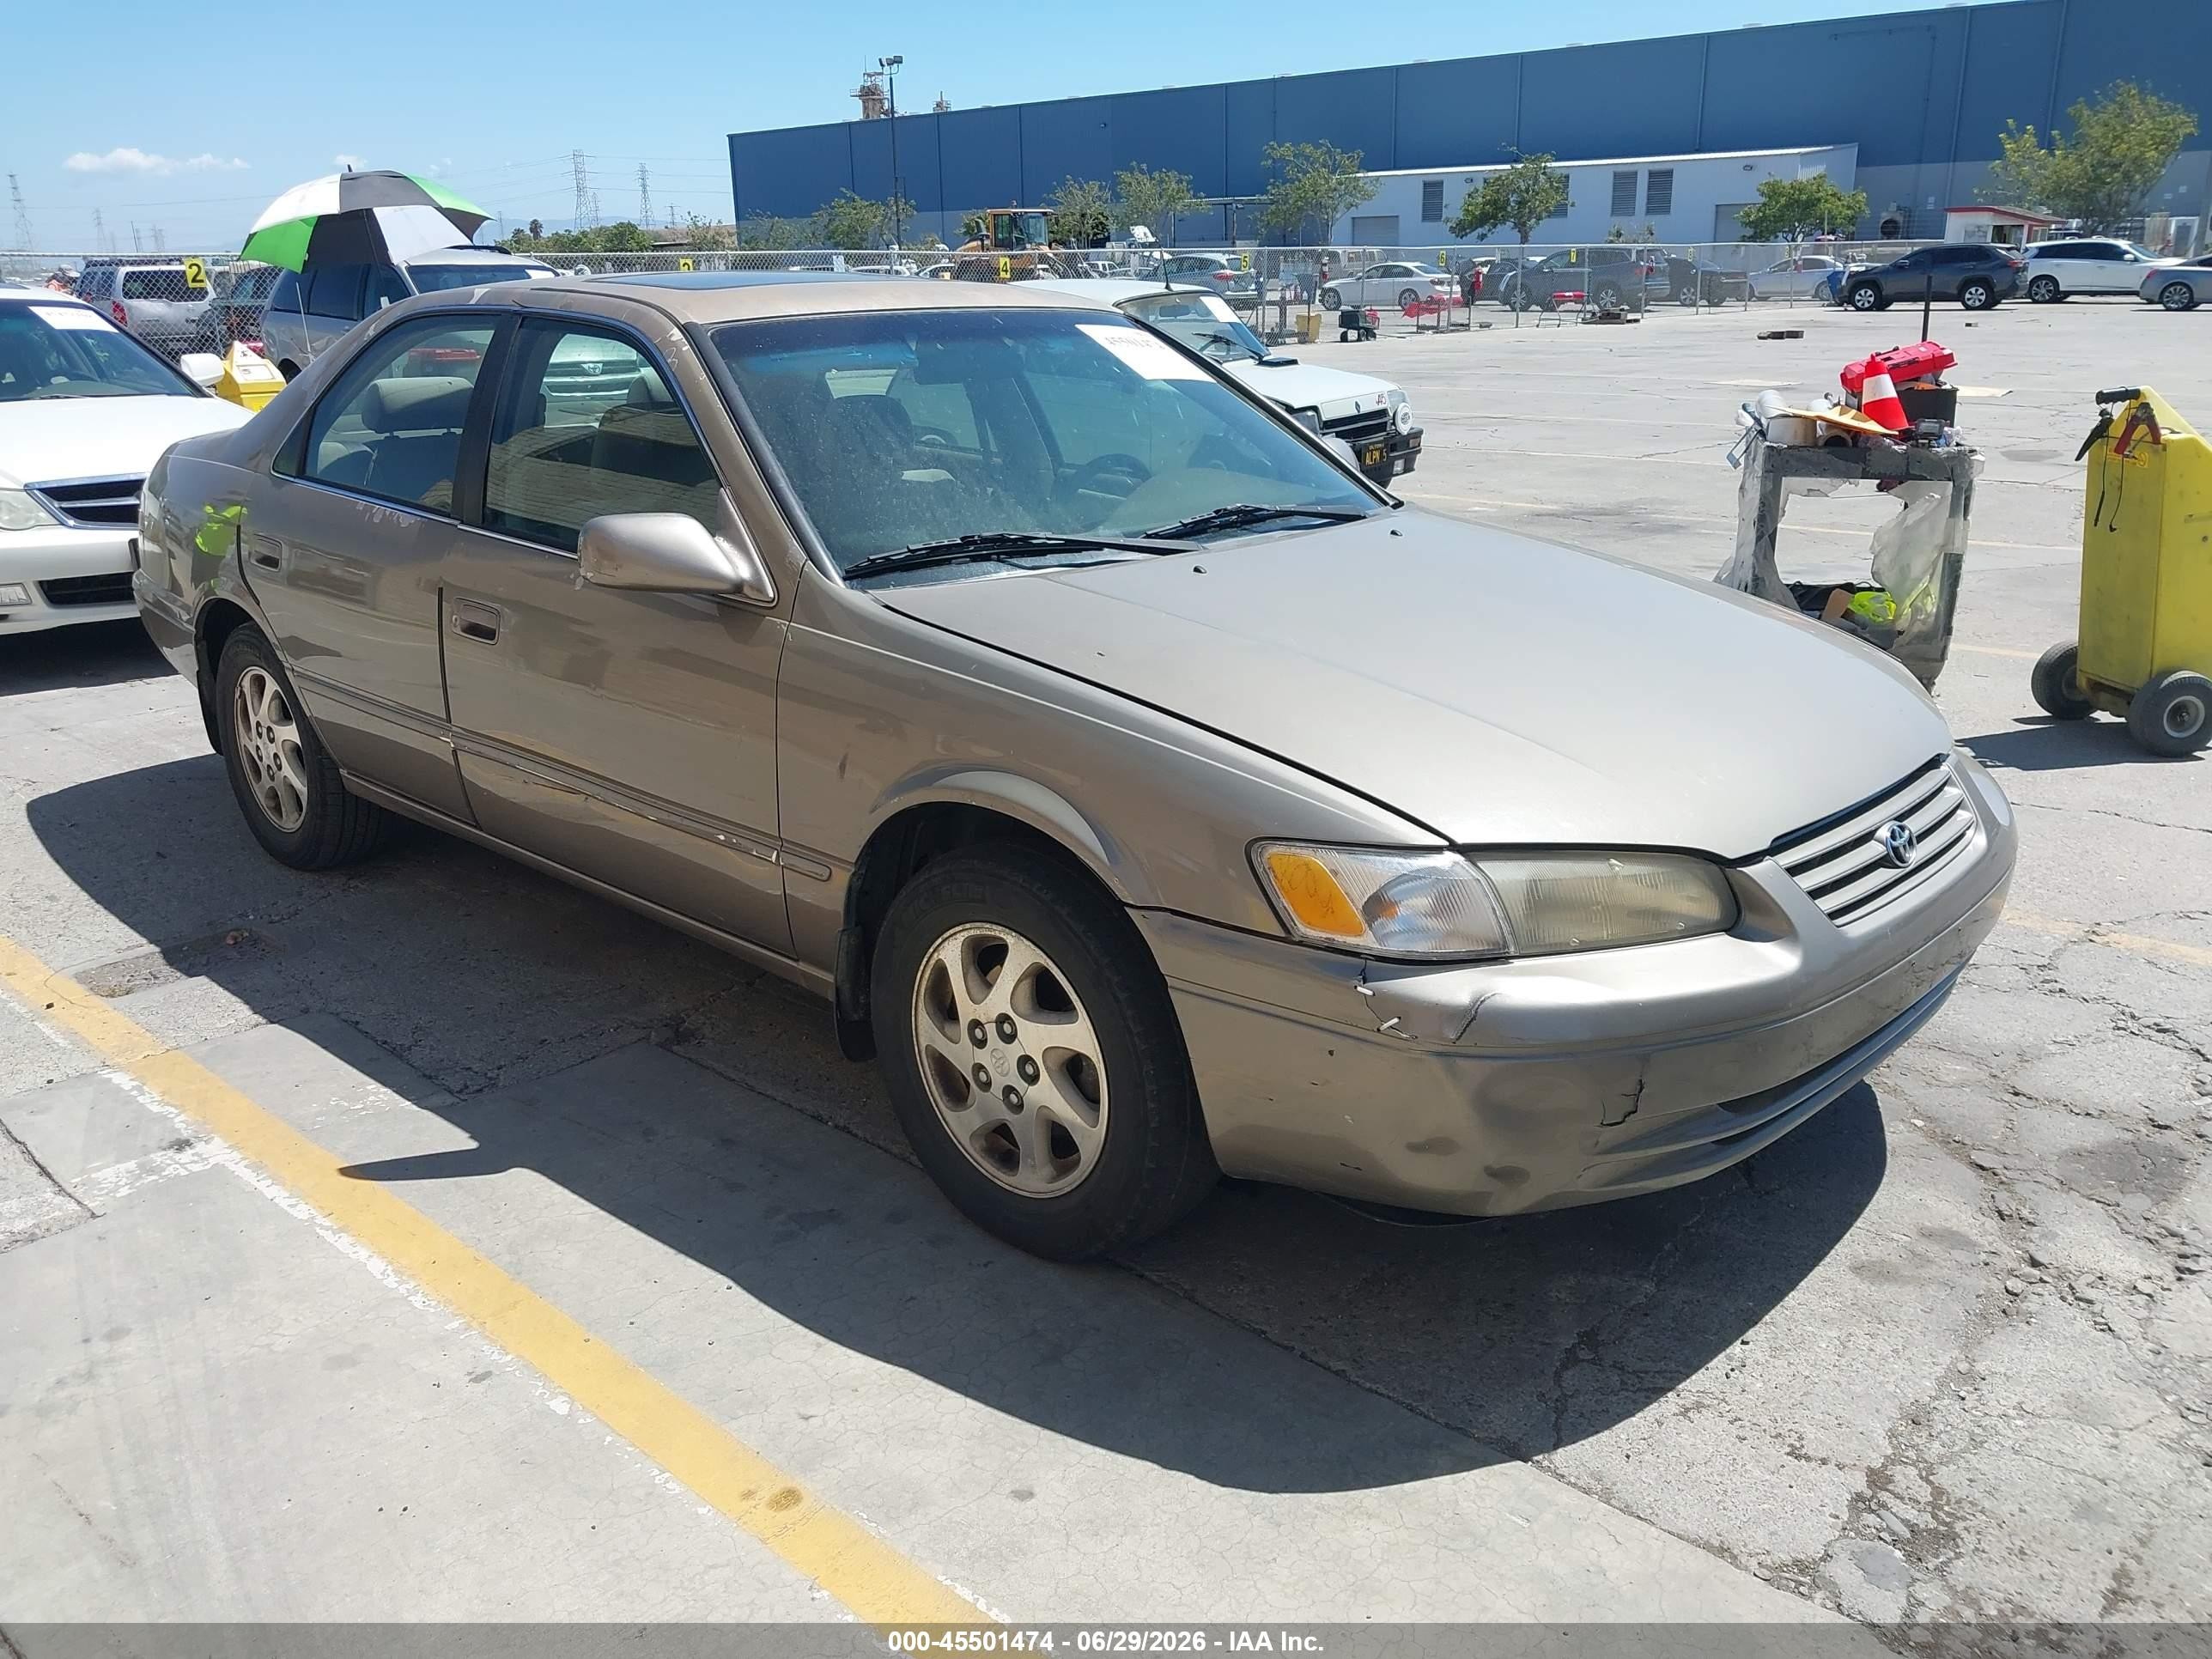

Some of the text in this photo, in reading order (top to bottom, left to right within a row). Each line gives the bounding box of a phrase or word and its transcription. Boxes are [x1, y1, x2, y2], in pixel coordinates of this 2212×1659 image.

[1242, 255, 1249, 268] 5
[1440, 252, 1445, 264] 6
[188, 263, 204, 283] 2
[1001, 260, 1008, 275] 4
[1365, 449, 1381, 465] ALPN
